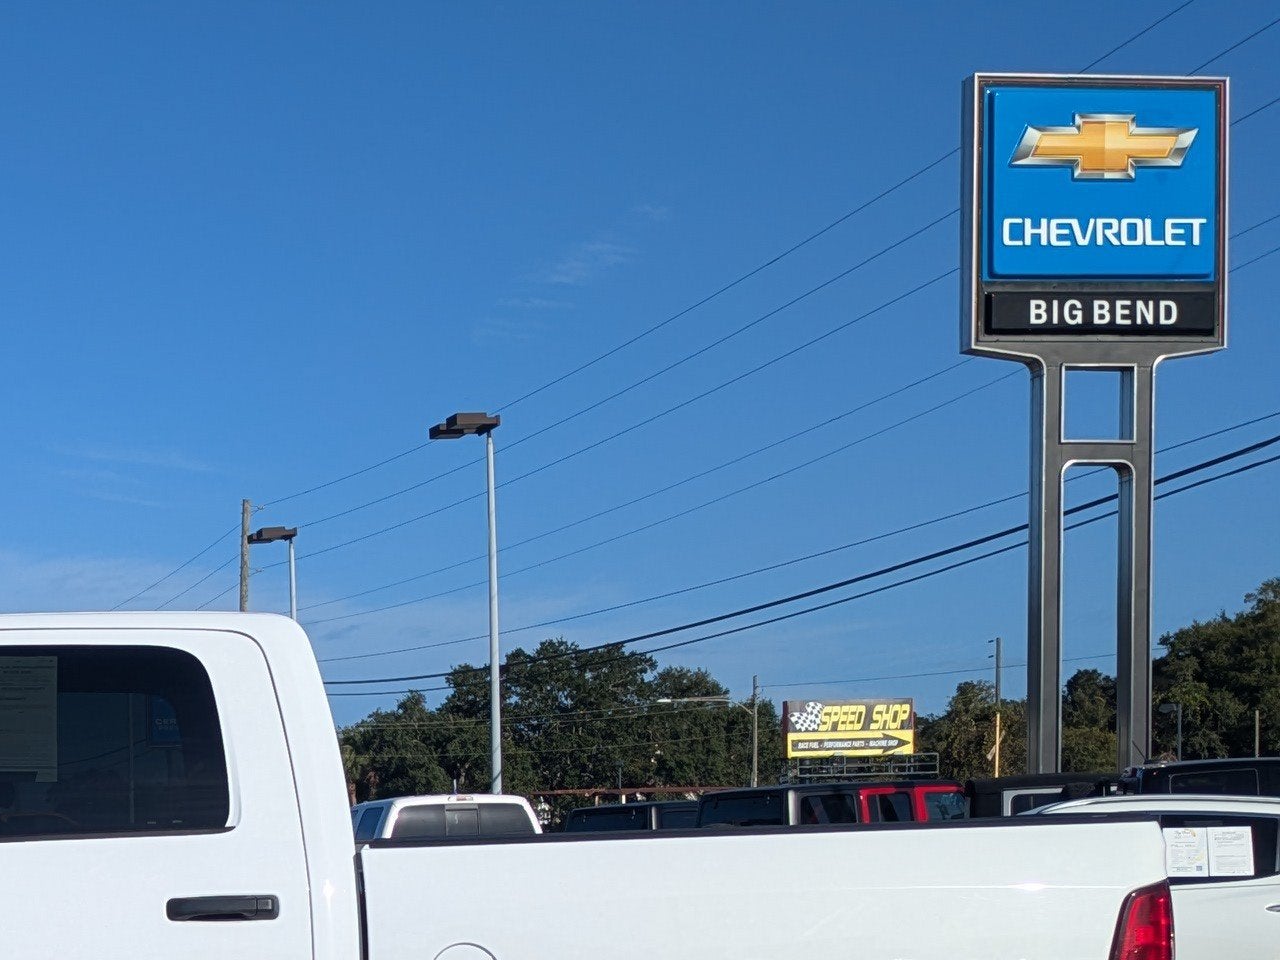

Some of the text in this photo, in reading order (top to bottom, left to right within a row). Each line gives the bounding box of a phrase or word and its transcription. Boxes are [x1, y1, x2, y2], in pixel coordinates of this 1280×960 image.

[1003, 217, 1207, 246] CHEVROLET
[1029, 299, 1178, 325] BIG BEND
[818, 704, 910, 731] SPEED SHOP
